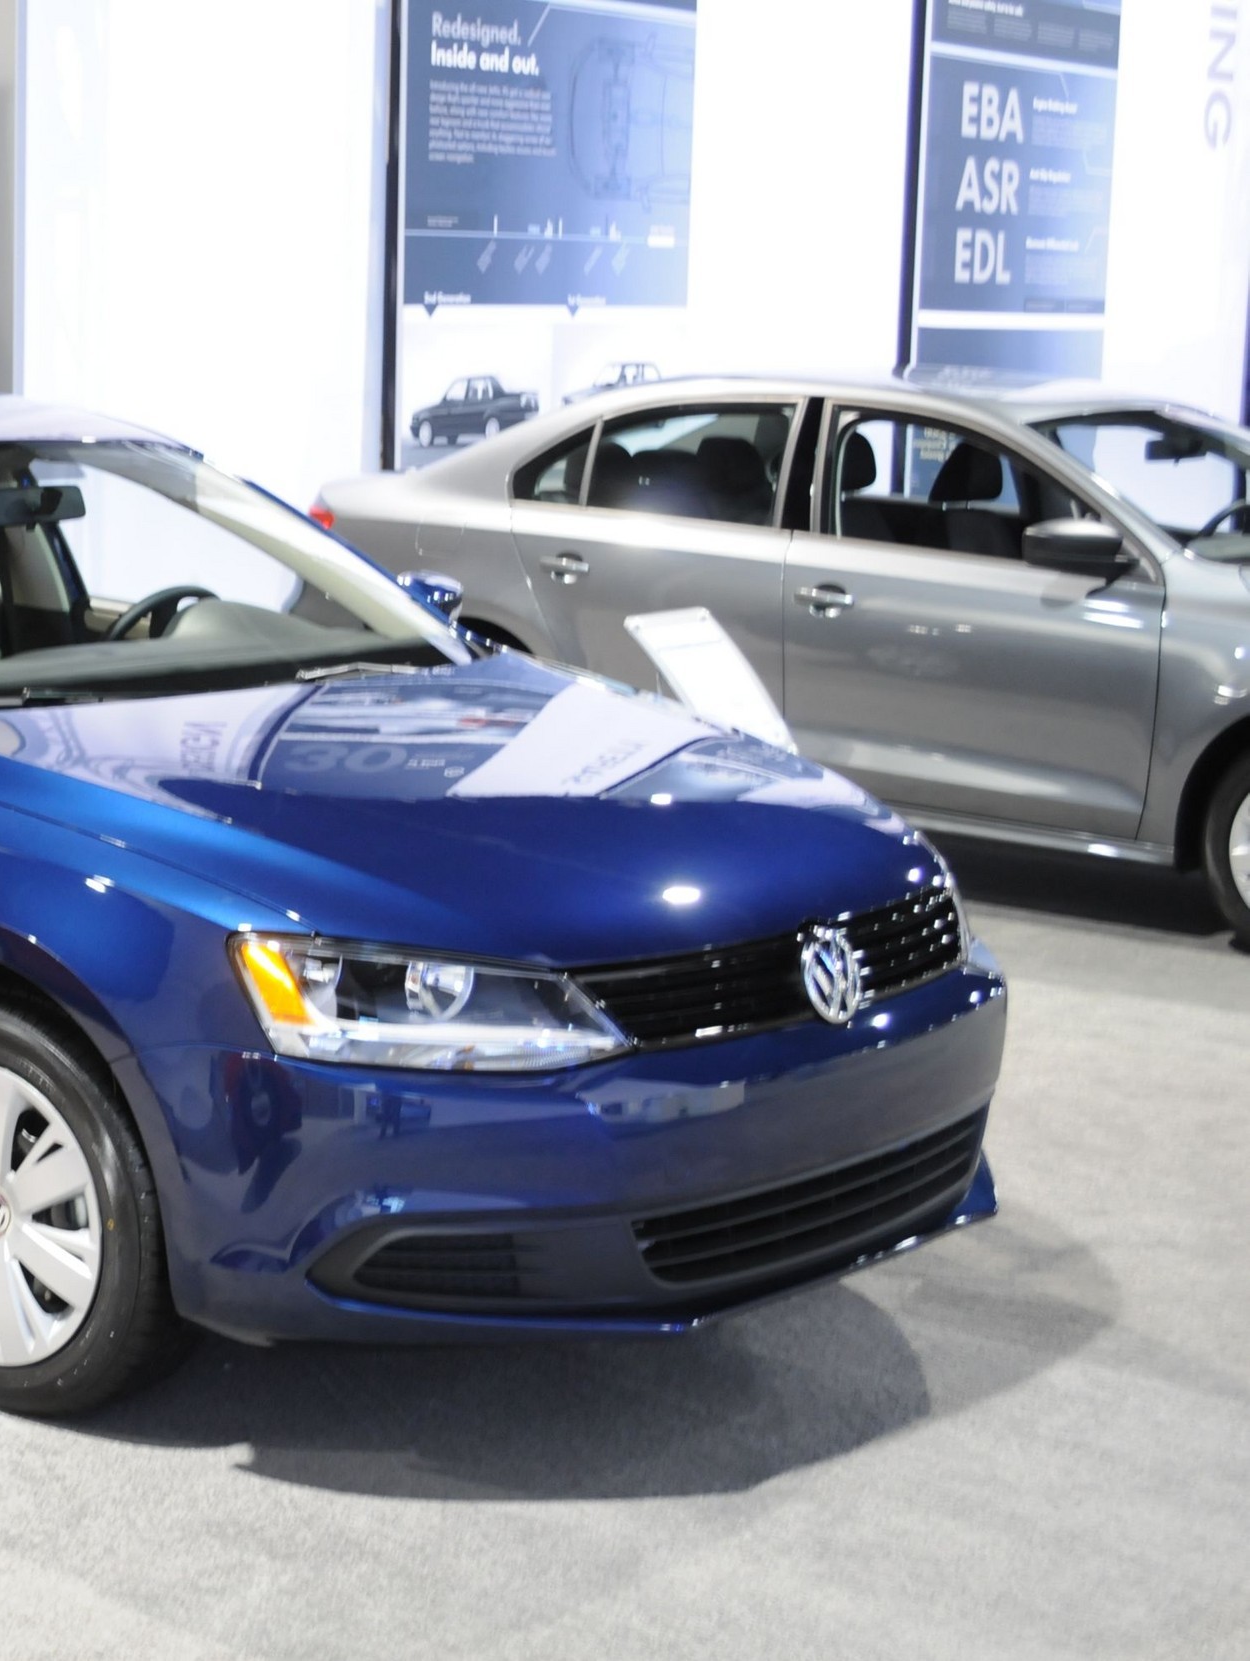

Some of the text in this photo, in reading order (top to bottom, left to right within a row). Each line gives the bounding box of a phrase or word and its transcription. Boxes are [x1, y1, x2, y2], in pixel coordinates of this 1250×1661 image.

[431, 40, 539, 76] Inside and out.
[432, 11, 521, 48] Redesigned.
[961, 81, 1023, 144] EBA
[955, 155, 1020, 216] ASR
[954, 227, 1011, 285] EDL
